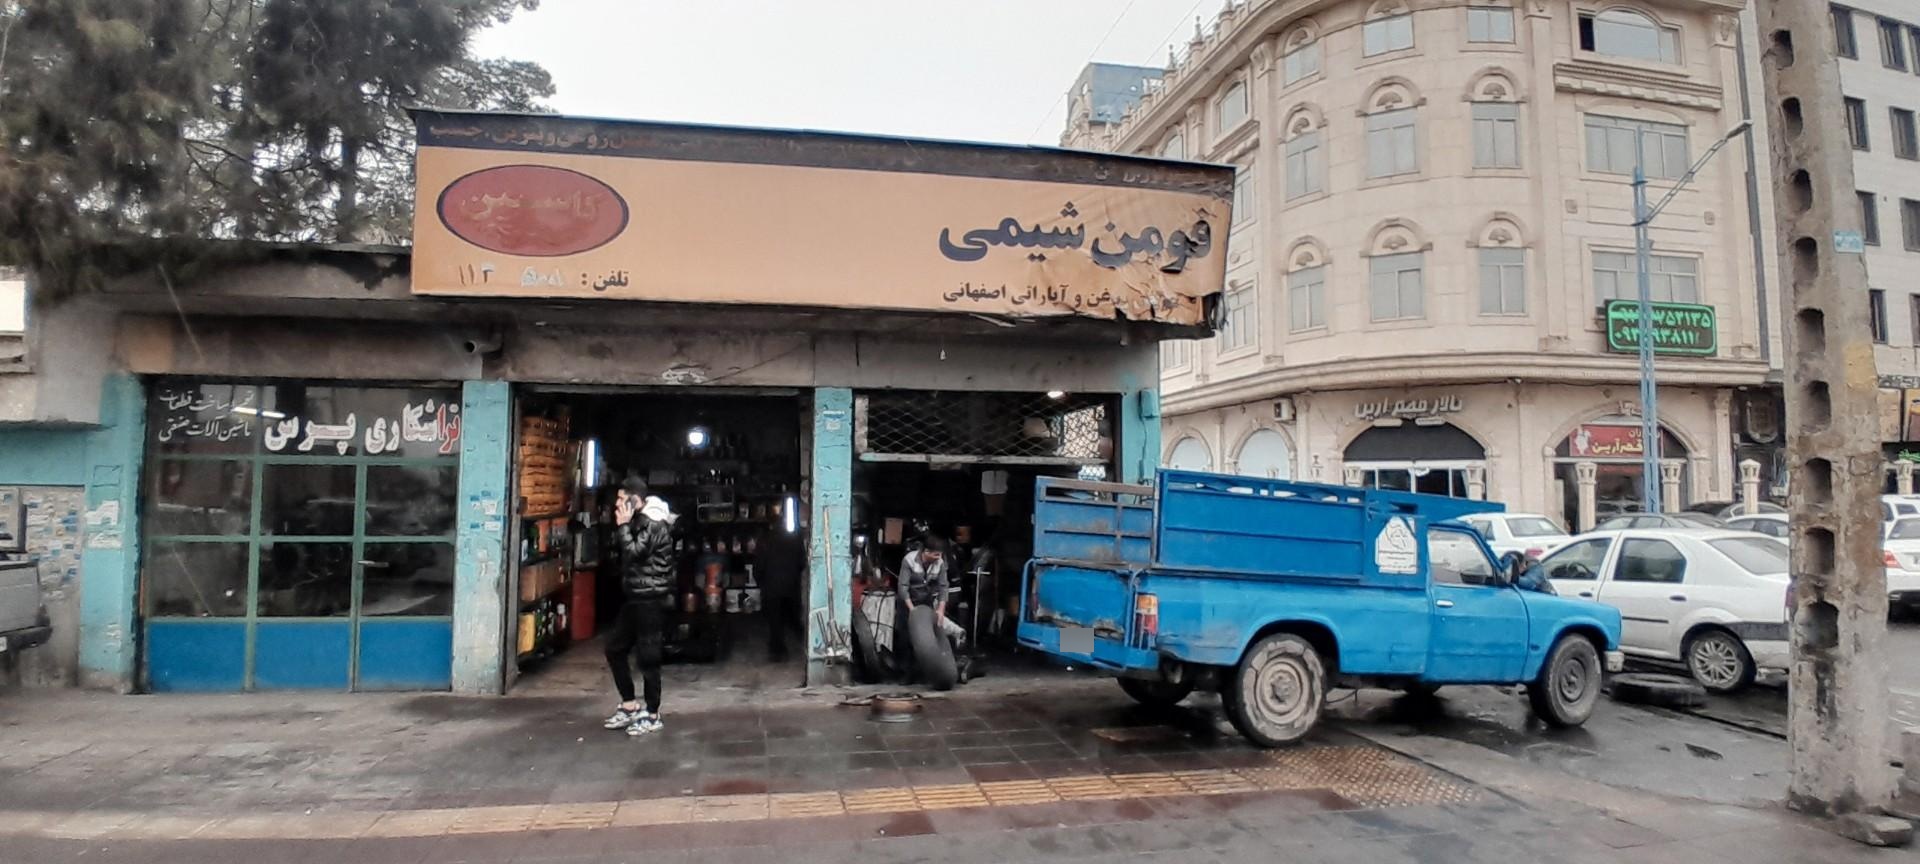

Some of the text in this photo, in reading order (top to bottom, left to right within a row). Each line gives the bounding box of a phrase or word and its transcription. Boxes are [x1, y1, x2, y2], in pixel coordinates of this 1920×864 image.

[939, 201, 1086, 262] شیمی
[943, 282, 1007, 302] اصفهانی
[265, 412, 356, 455] پرس
